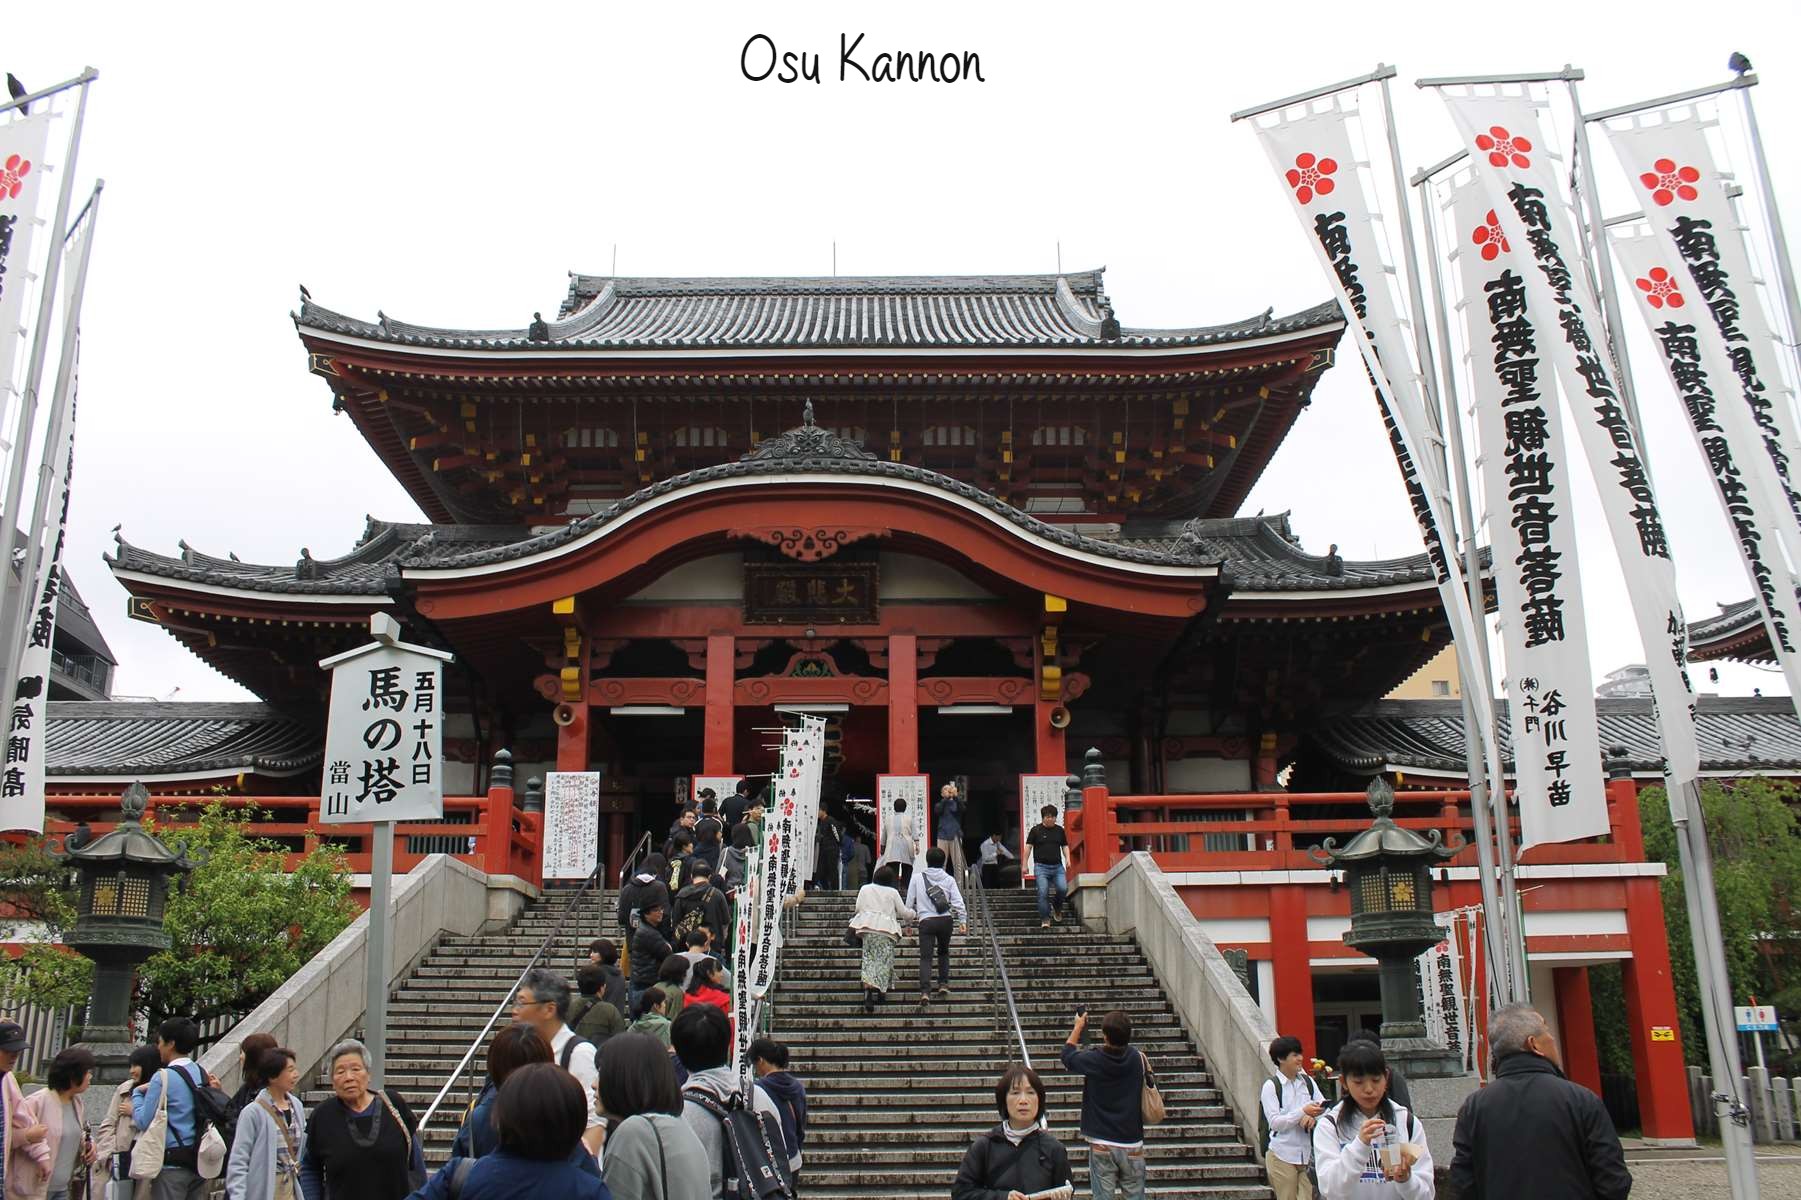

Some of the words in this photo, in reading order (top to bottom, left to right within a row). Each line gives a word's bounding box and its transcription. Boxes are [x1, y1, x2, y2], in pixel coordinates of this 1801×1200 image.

[355, 666, 409, 804] 馬の塔
[412, 671, 434, 784] 五月十八日
[328, 760, 351, 815] 當山
